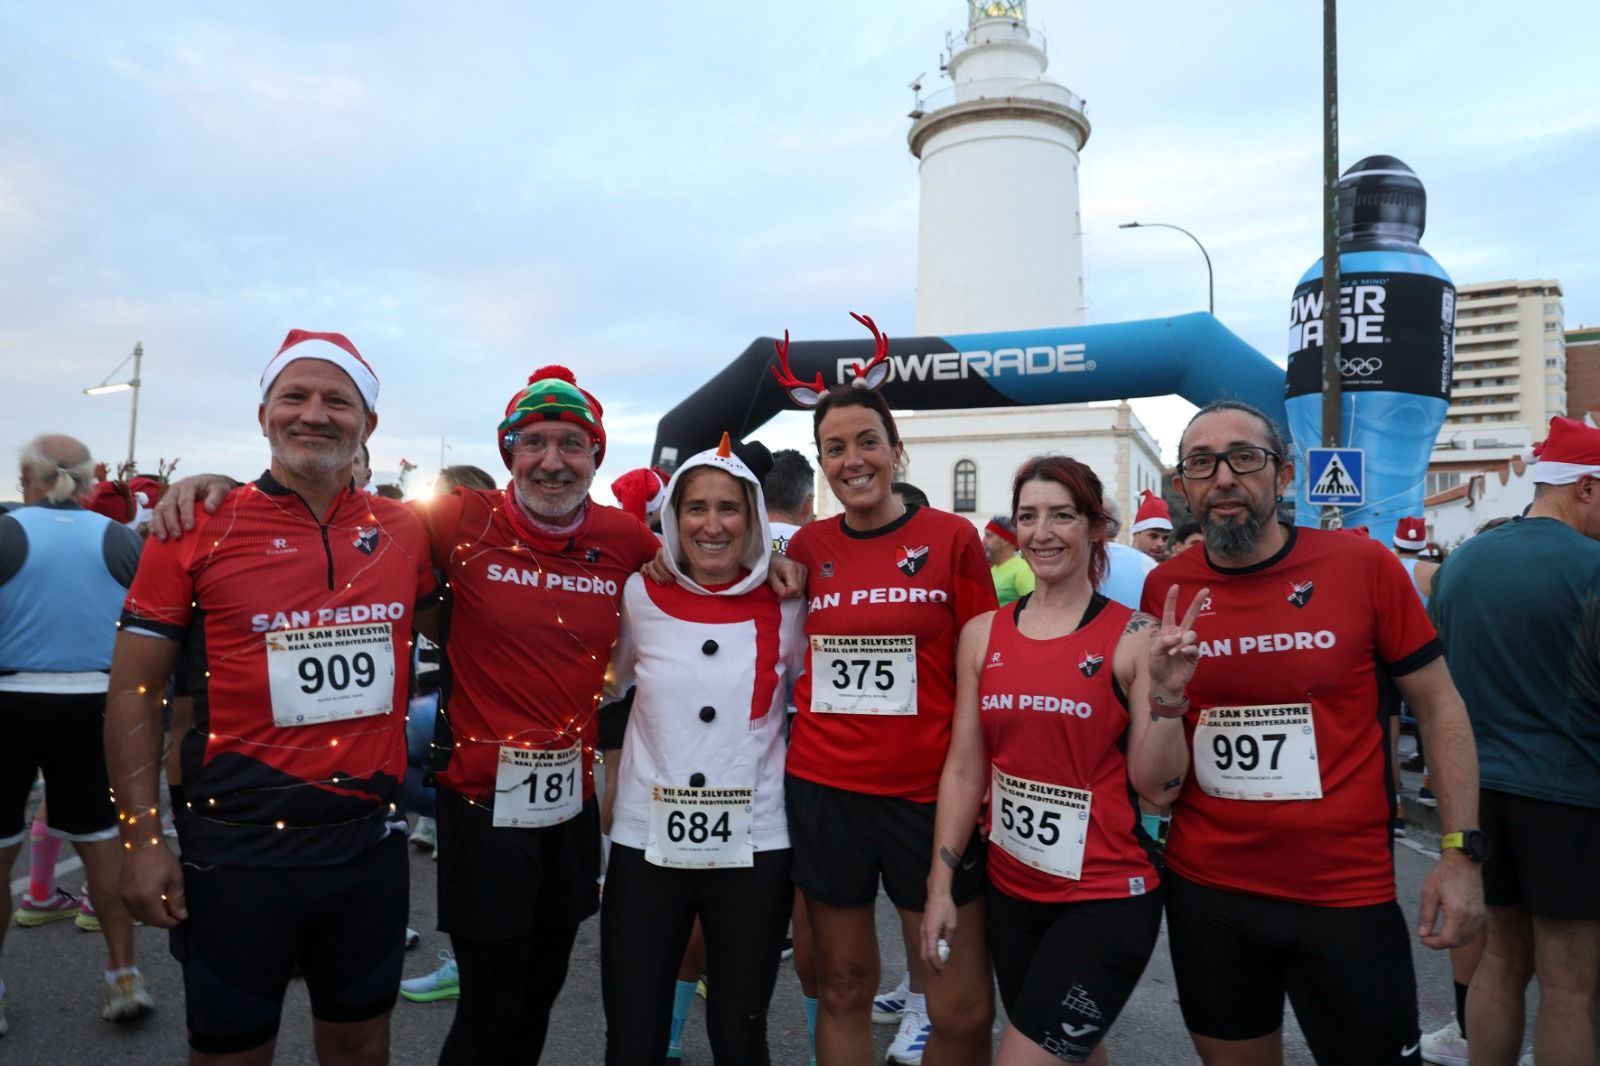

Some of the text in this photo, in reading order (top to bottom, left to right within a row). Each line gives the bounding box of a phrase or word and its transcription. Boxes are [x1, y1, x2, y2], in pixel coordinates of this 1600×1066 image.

[1290, 285, 1386, 327] OWER
[1302, 315, 1384, 351] ADE
[487, 564, 617, 596] SAN PEDRO
[808, 587, 947, 615] AN PEDRO
[251, 602, 405, 632] SAN PEDRO
[285, 624, 391, 642] VII SAN SILVESTRE
[860, 637, 913, 646] SILVESTRE
[1199, 630, 1336, 658] AN PEDRO
[298, 652, 376, 694] 909
[831, 659, 894, 690] 375
[982, 694, 1092, 719] SAN PEDRO
[1219, 709, 1240, 718] SAN
[1244, 707, 1309, 718] SILVESTRE
[514, 751, 529, 759] VII
[532, 752, 554, 760] SAN
[1213, 734, 1286, 771] 997
[522, 768, 575, 803] 181
[663, 788, 752, 797] VII SAN SILVESTRE
[1006, 778, 1026, 790] SAN
[1029, 784, 1089, 801] SILVESTRE
[1009, 789, 1025, 798] CLUB
[667, 810, 732, 843] 684
[1001, 798, 1061, 846] 535
